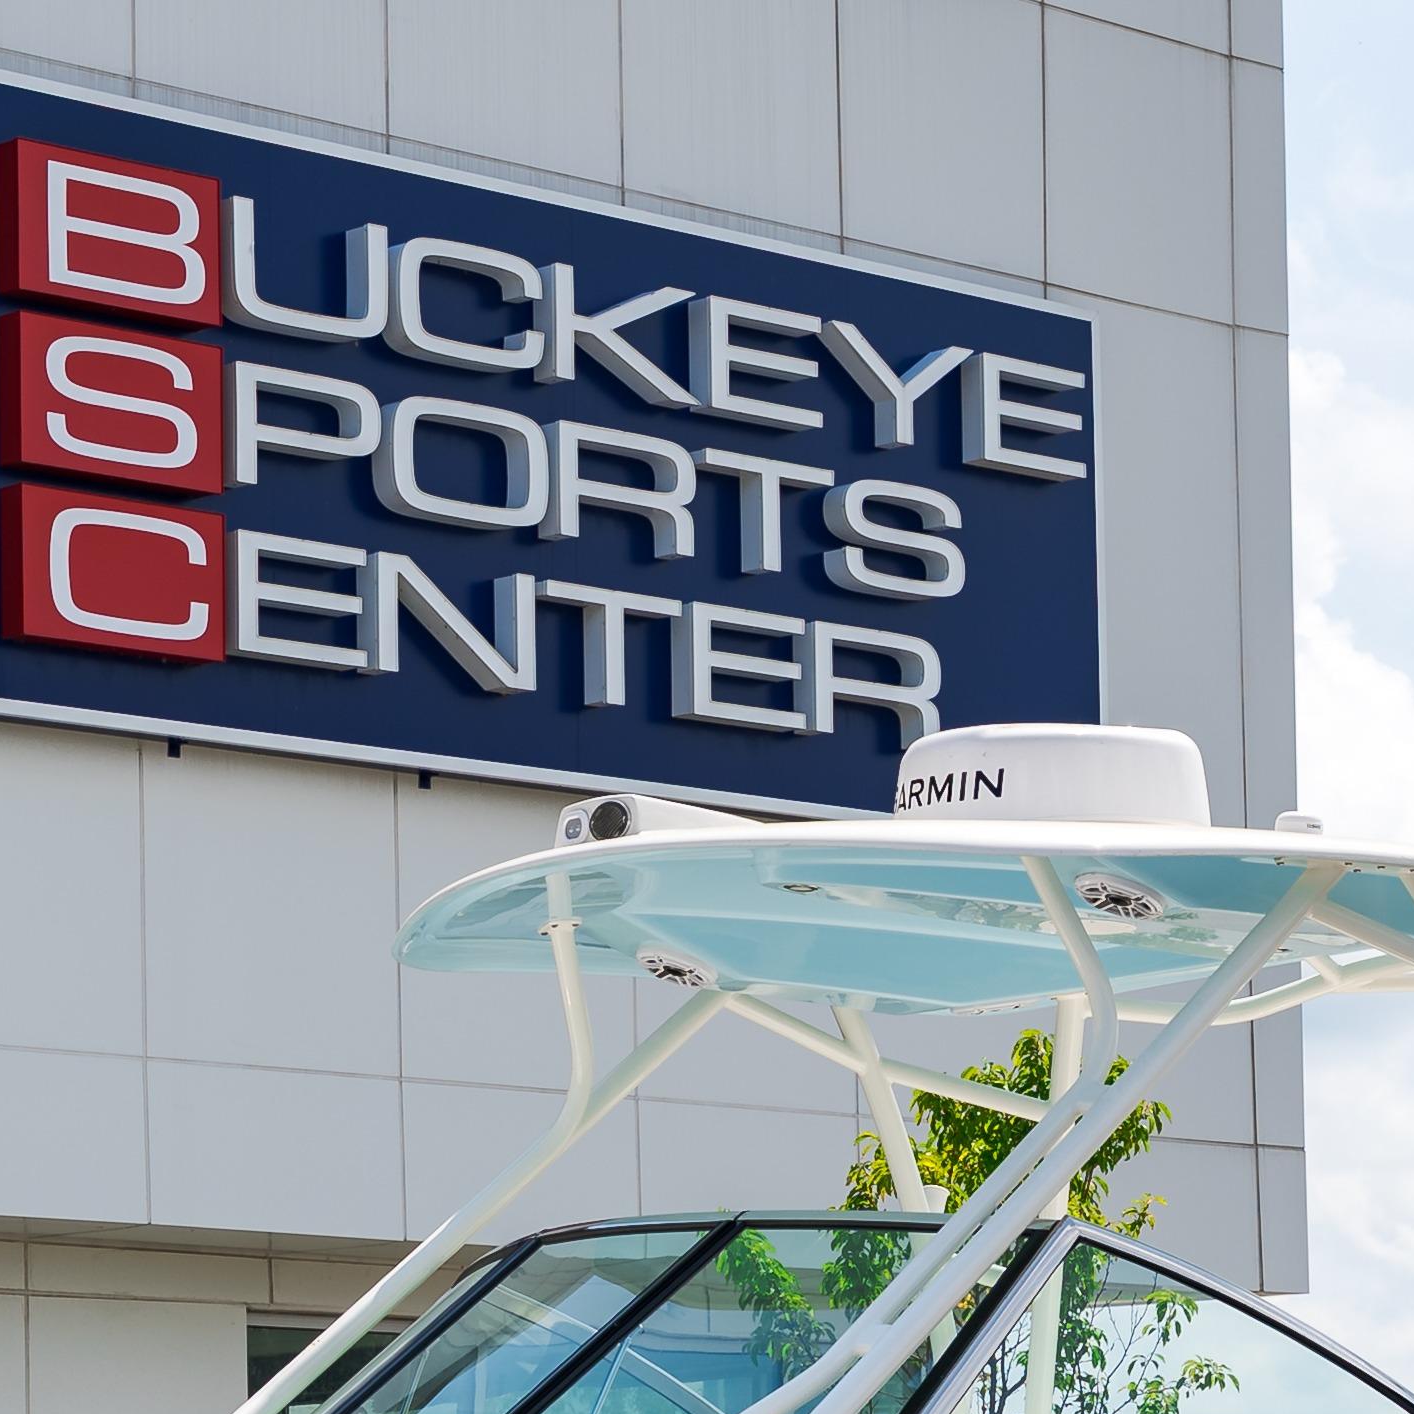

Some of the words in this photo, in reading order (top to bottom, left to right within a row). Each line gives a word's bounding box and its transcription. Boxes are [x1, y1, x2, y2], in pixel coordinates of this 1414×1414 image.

[47, 159, 1086, 481] BUCKEYE
[45, 335, 966, 601] SPORTS
[48, 506, 943, 750] CENTER
[895, 768, 1005, 811] ARMIN
